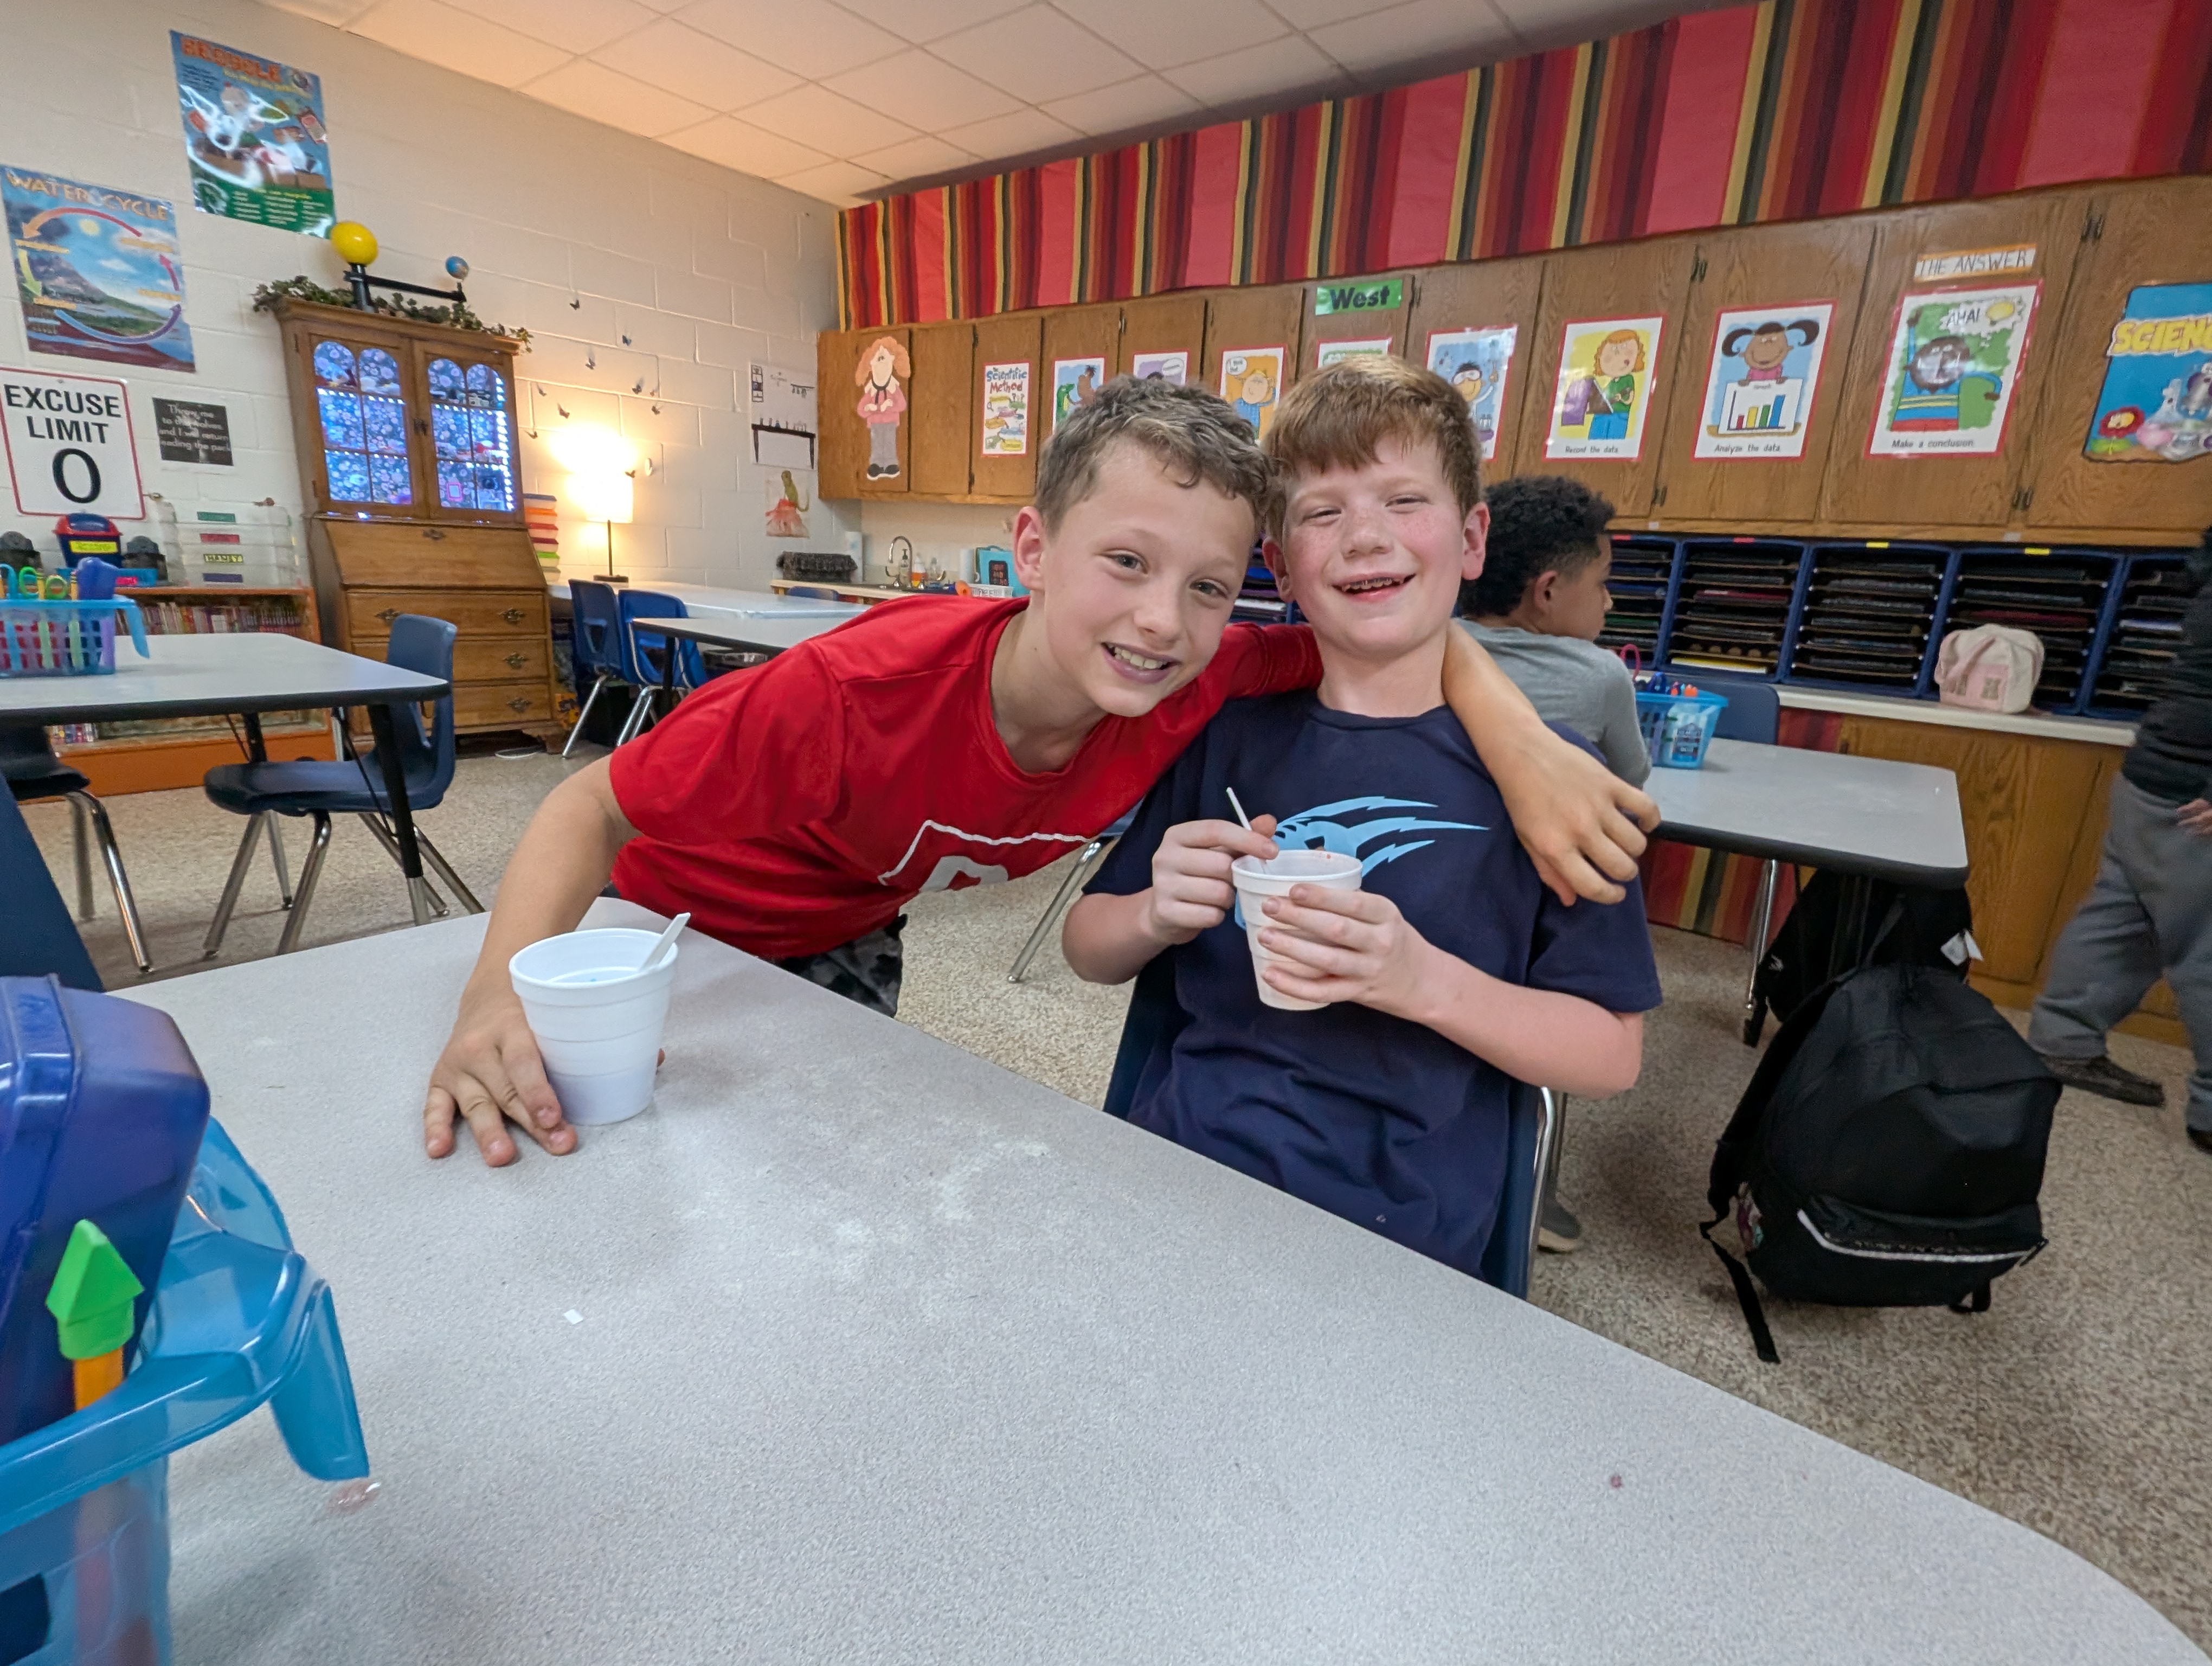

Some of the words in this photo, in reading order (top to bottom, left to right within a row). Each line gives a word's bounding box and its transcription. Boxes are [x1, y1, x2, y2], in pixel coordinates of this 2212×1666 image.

[7, 172, 88, 203] WATER
[104, 194, 169, 221] CYCLE
[1953, 249, 2027, 273] ANSWER
[1329, 285, 1390, 310] West
[986, 367, 1027, 382] Scientific
[990, 381, 1023, 394] Method
[4, 384, 122, 418] EXCUSE
[27, 415, 109, 444] LIMIT
[160, 437, 192, 450] eading
[1714, 444, 1743, 455] Analyze
[1748, 444, 1759, 452] the
[1764, 443, 1780, 452] data
[1892, 439, 1914, 448] Make
[1927, 439, 1974, 447] conclusion
